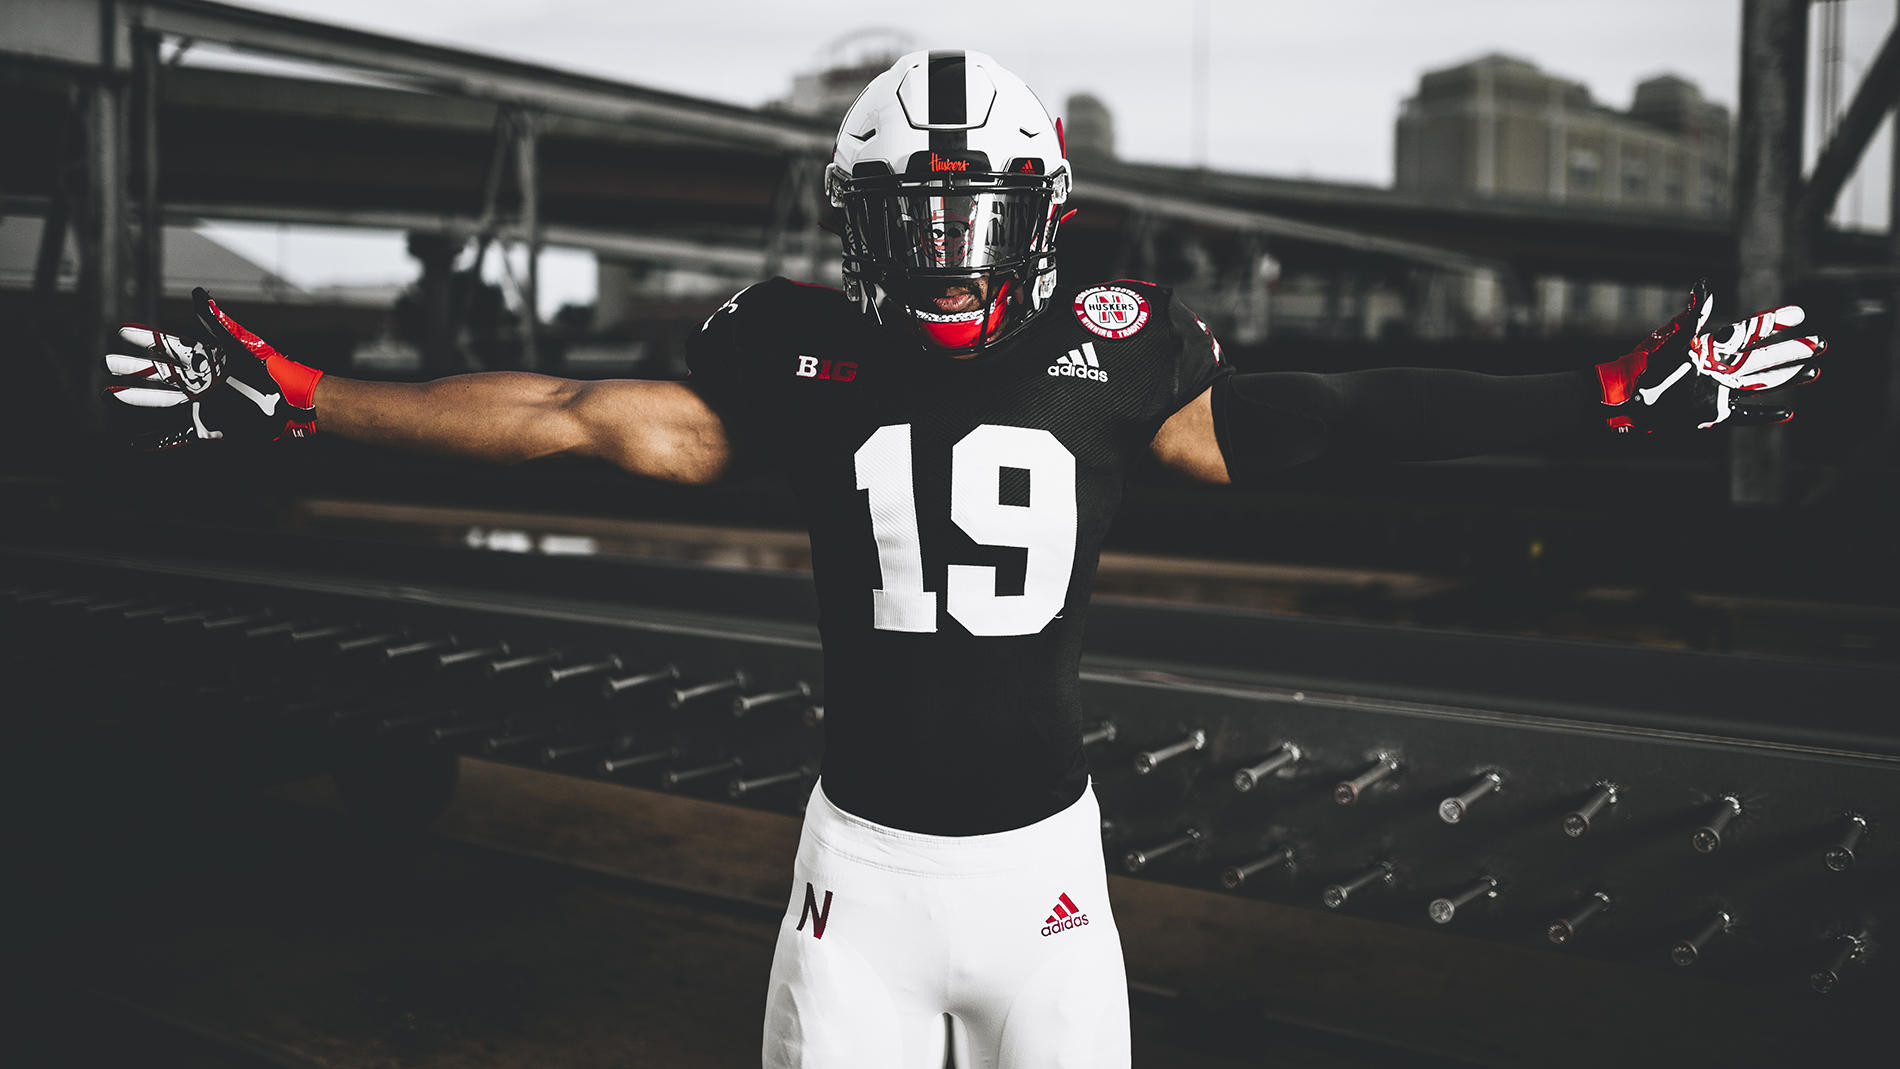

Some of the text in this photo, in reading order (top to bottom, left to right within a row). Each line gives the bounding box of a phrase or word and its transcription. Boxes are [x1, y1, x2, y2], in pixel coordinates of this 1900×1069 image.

[929, 152, 970, 172] Huskers
[1088, 303, 1135, 311] HUSKERS
[1081, 316, 1113, 338] WINNING
[1117, 310, 1148, 338] TRADITION
[1047, 362, 1108, 383] adidas
[854, 423, 1077, 636] 19
[796, 881, 834, 940] N
[1041, 914, 1089, 937] adidas
